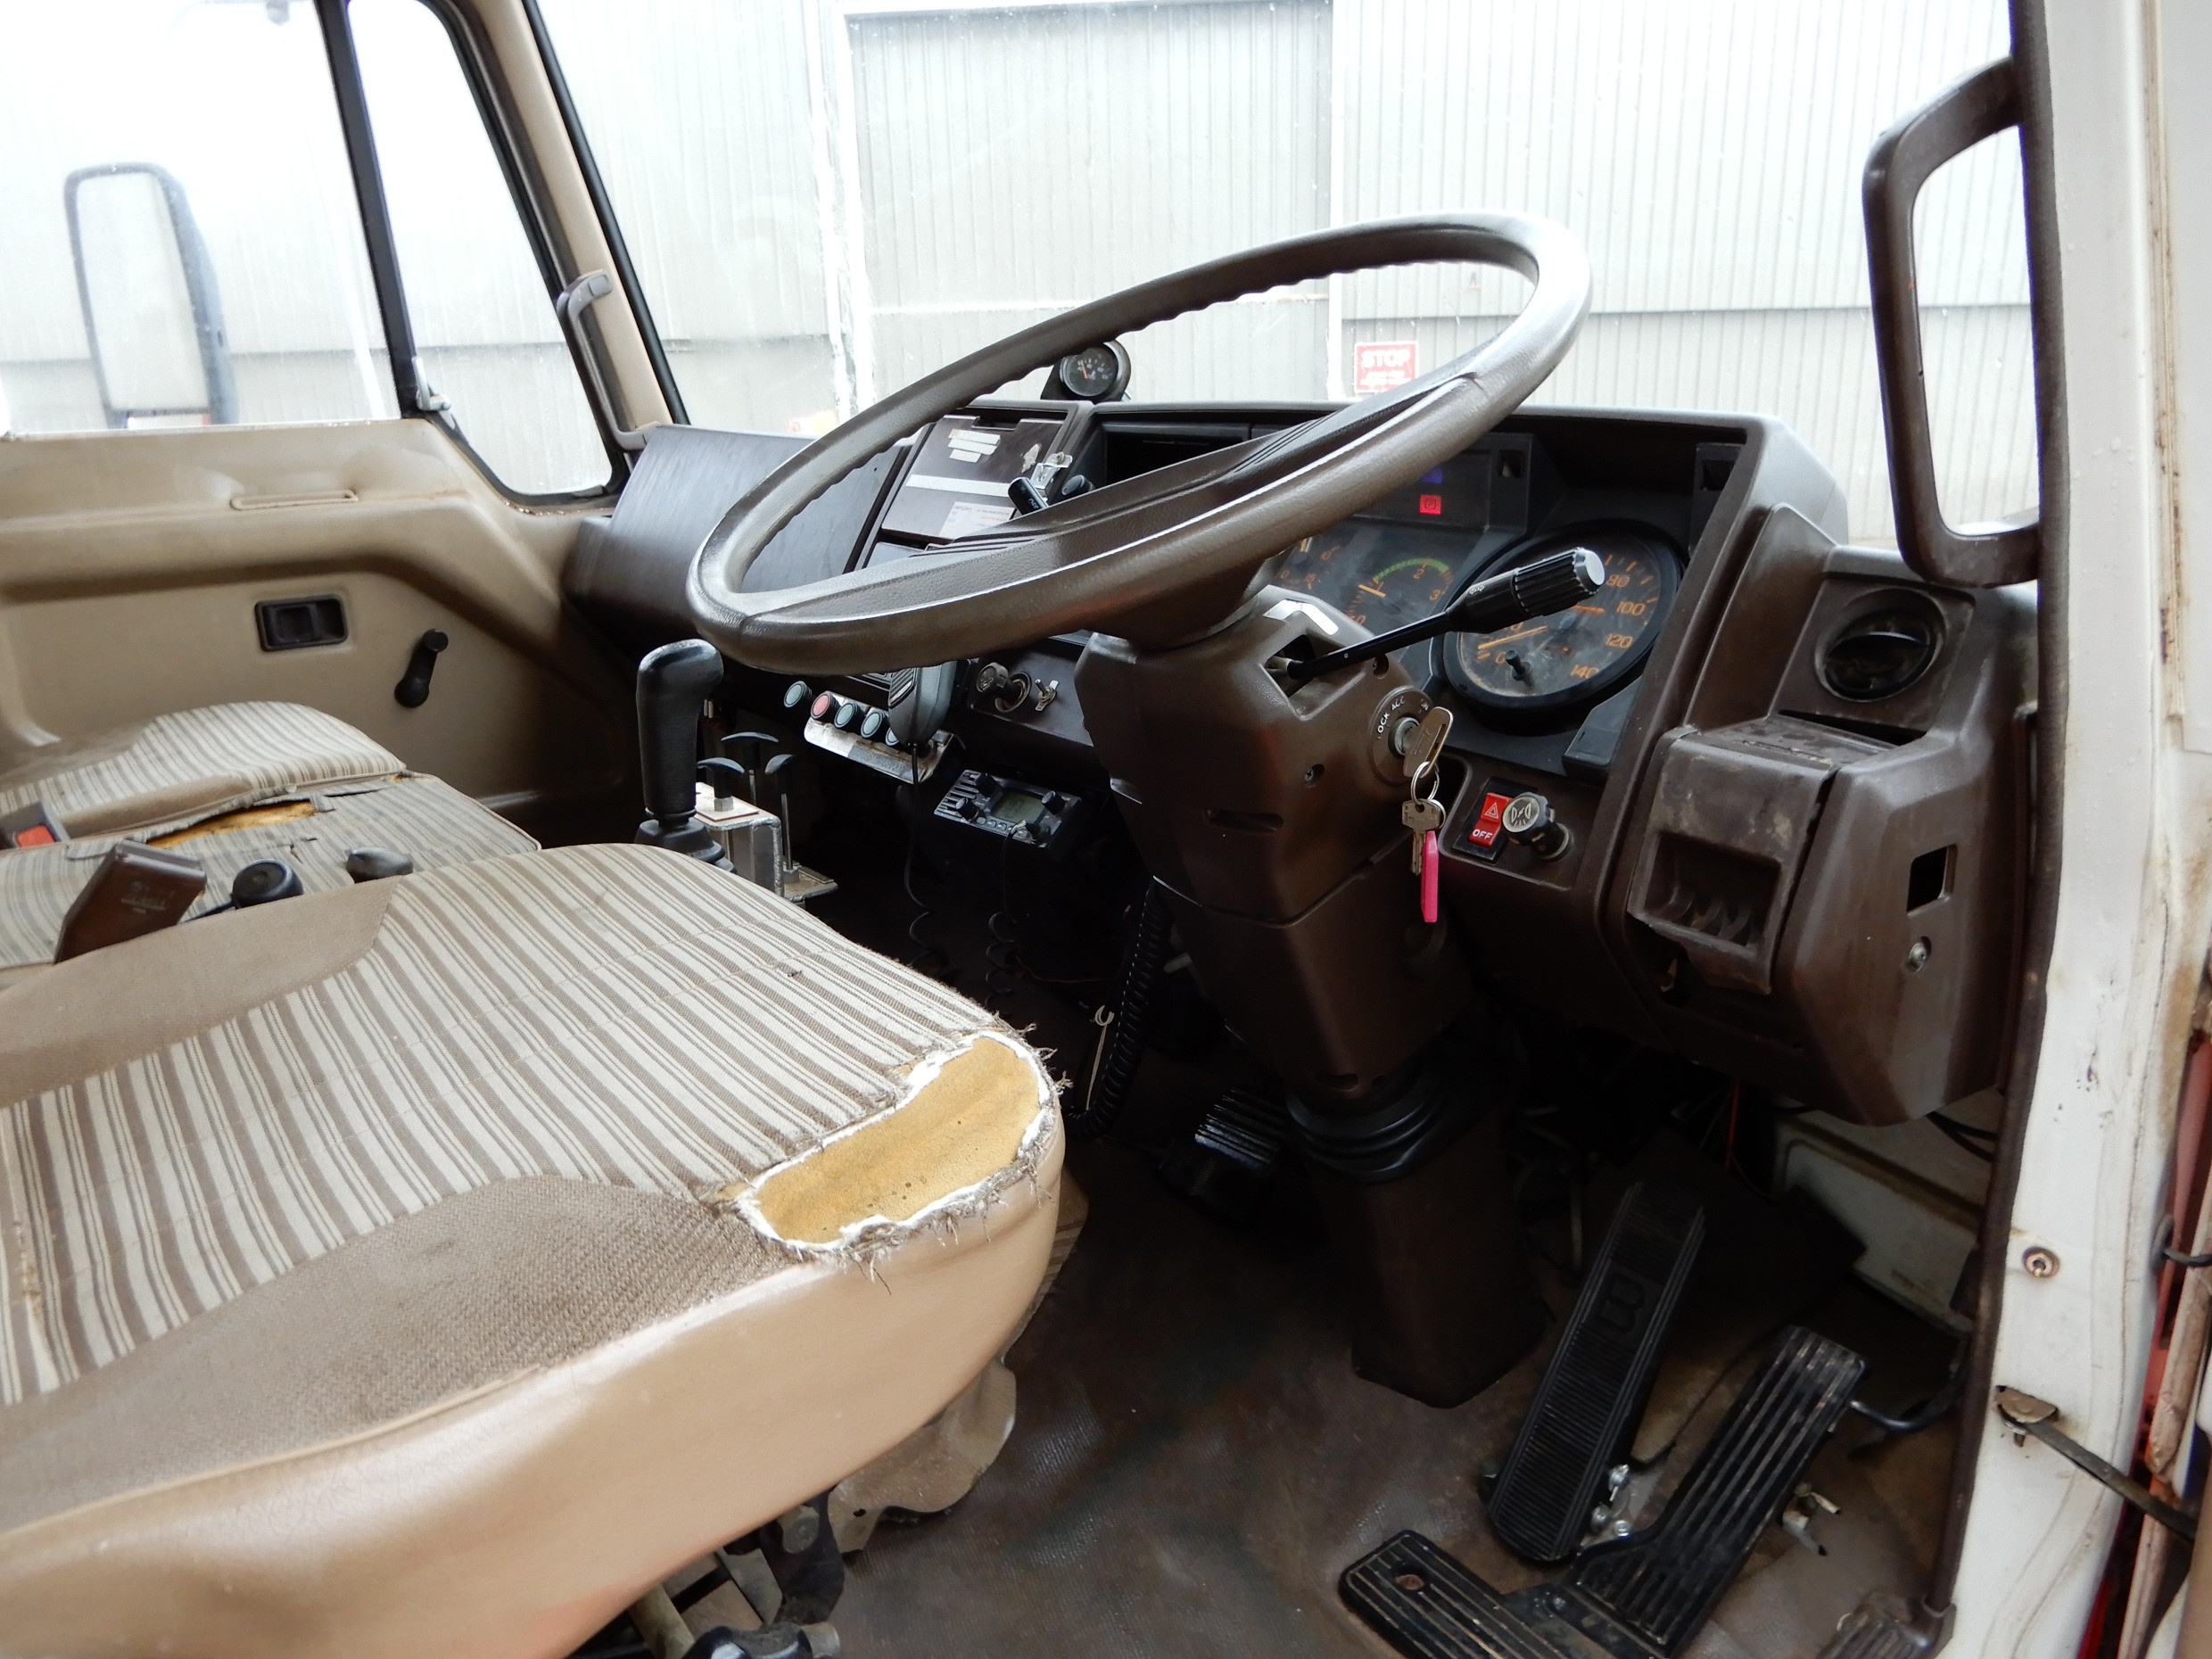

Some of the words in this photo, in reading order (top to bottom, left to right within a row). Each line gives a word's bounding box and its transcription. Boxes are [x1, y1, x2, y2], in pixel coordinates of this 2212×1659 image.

[1361, 349, 1410, 367] STOP
[1412, 568, 1425, 580] 2
[1605, 574, 1630, 588] 80
[1429, 589, 1441, 601] 3
[1616, 600, 1646, 616] 100
[1605, 633, 1634, 648] 120
[1472, 828, 1493, 840] OFF
[1594, 1270, 1647, 1334] B
